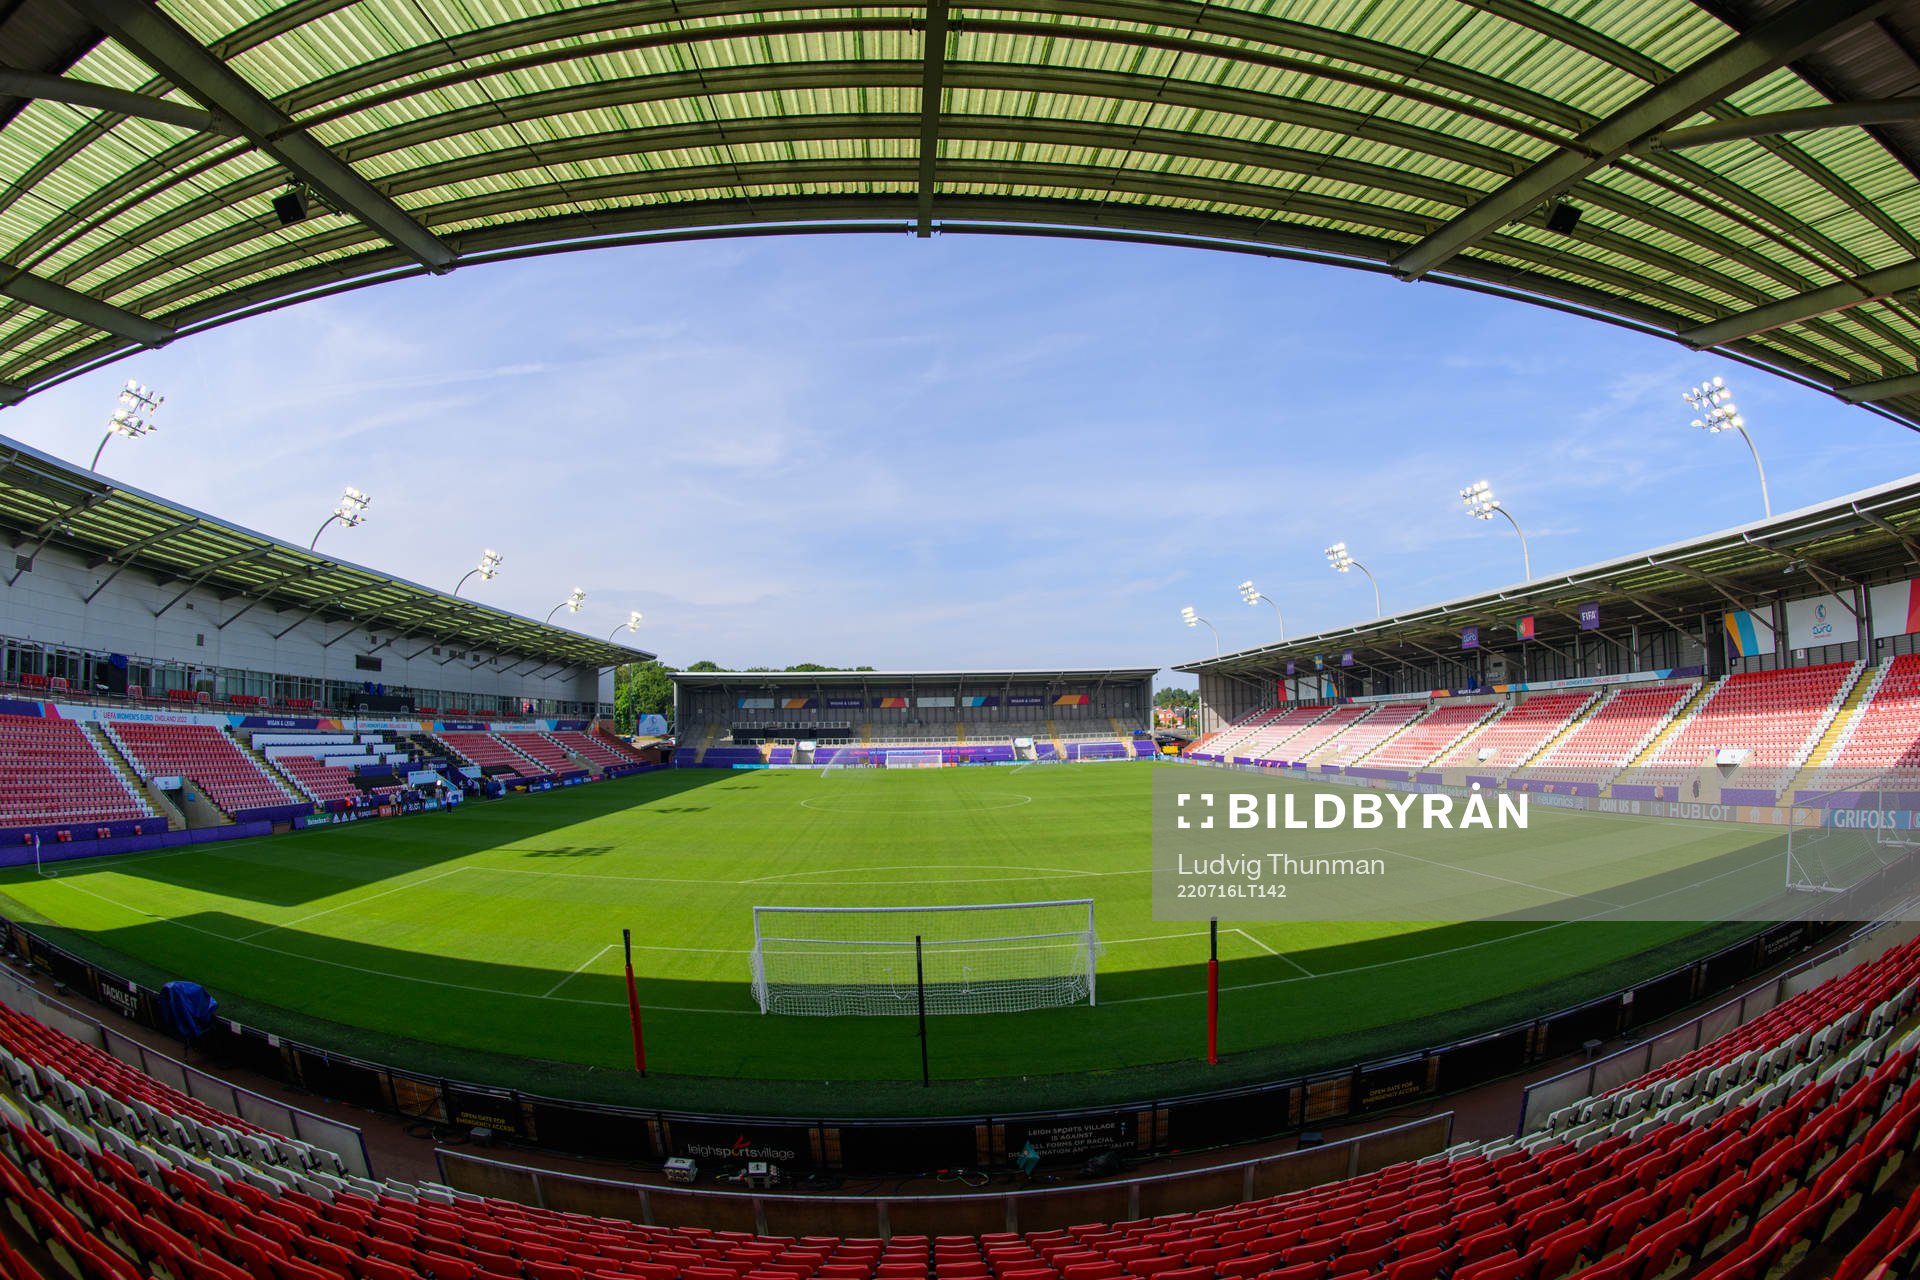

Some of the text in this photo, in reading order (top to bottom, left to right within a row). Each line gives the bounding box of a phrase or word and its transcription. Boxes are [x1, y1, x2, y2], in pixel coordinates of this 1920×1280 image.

[1598, 799, 1630, 813] JOIN US
[1669, 805, 1730, 821] HUBLOT
[1834, 809, 1896, 829] GRIFOLS
[1028, 1122, 1116, 1136] LEIGH SPORTS VILLAGE
[1060, 1132, 1093, 1140] AGAINST
[1047, 1140, 1073, 1148] FORMS
[1075, 1138, 1085, 1146] OF
[1087, 1136, 1114, 1144] RACIAL
[687, 1143, 796, 1161] leighsportsvillage
